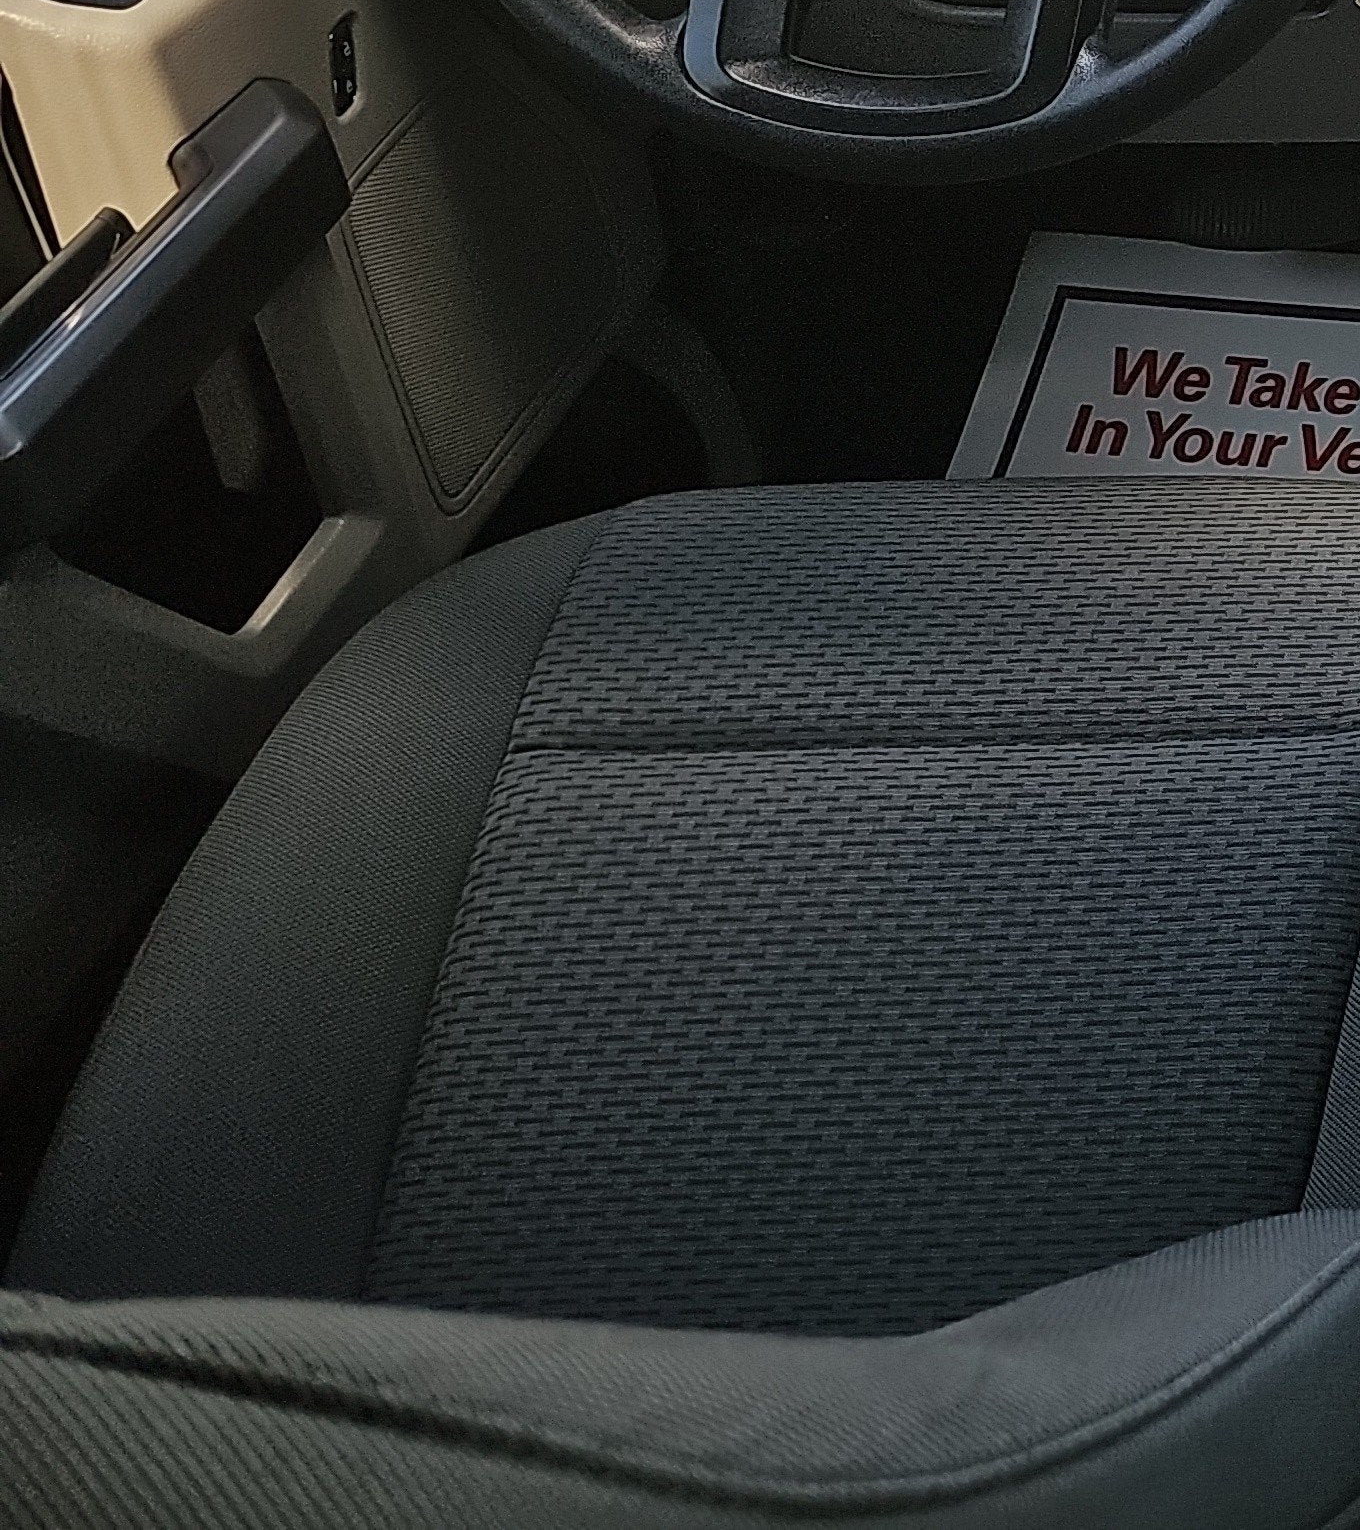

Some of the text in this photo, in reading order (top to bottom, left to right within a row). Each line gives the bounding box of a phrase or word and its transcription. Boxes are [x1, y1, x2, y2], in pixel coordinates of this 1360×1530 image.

[1111, 345, 1211, 404] We
[1224, 355, 1360, 415] Take
[1065, 403, 1129, 458] In
[1144, 410, 1288, 468] Your
